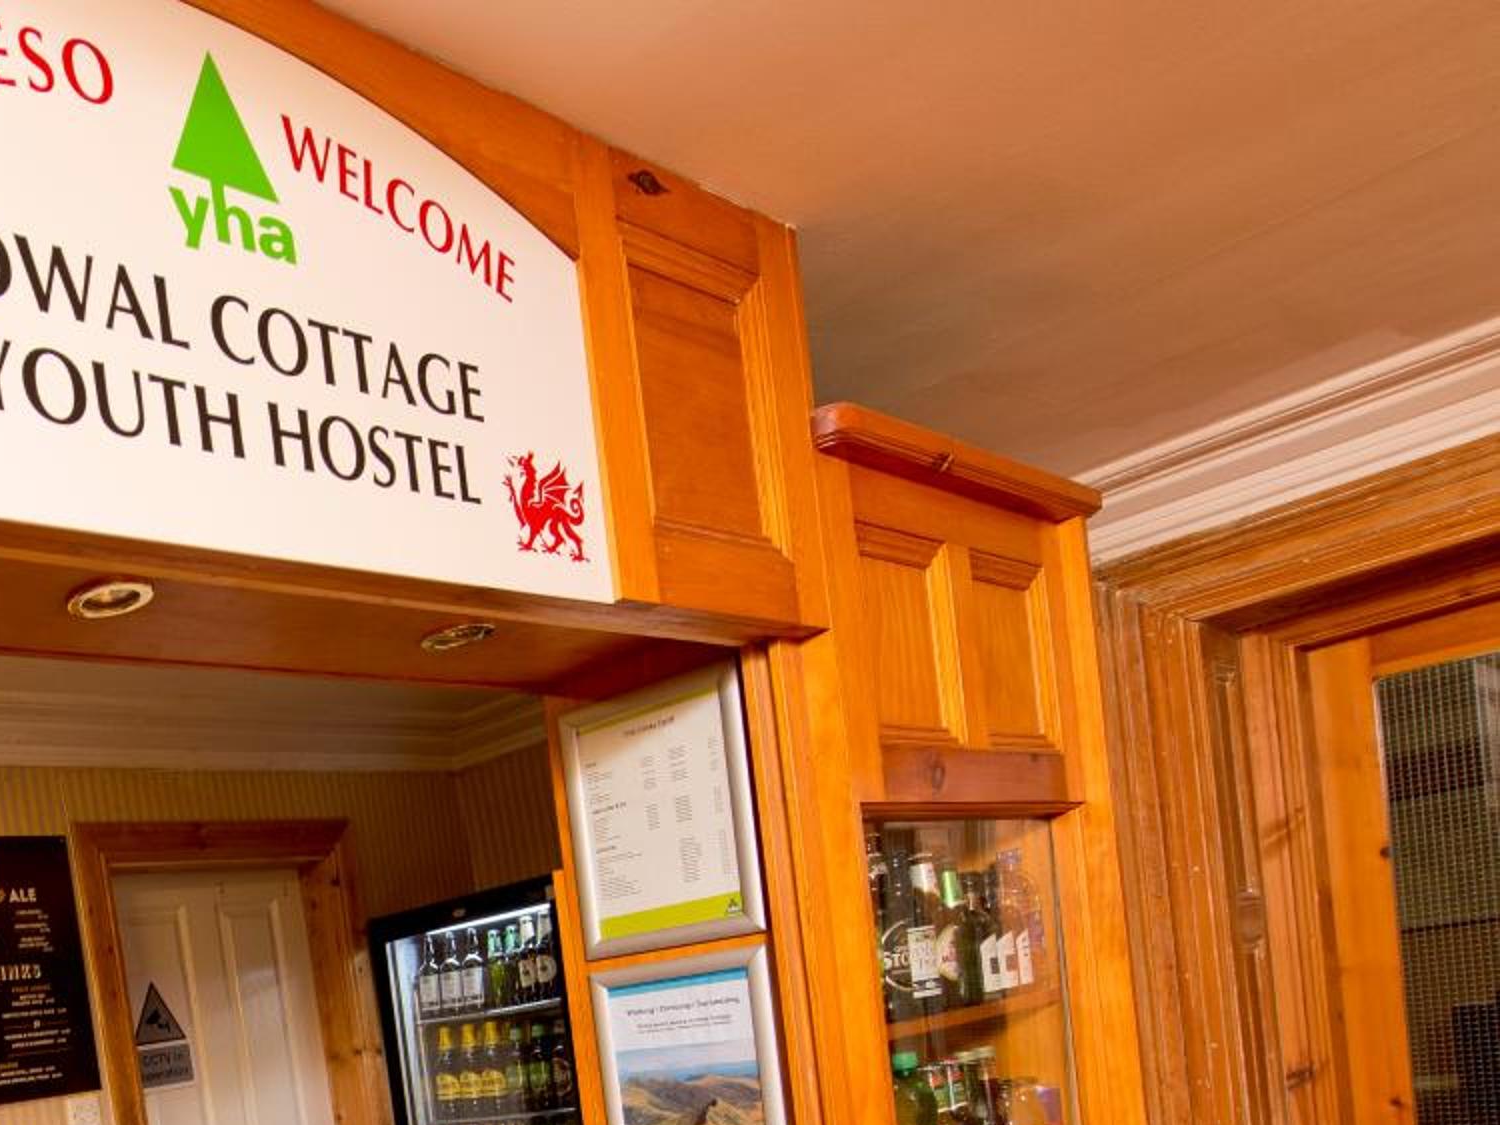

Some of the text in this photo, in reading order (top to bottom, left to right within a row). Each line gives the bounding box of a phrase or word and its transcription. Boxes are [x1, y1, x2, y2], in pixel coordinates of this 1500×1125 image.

[169, 186, 298, 266] yha
[280, 114, 516, 304] WELCOME
[210, 295, 485, 424] COTTAGE
[268, 402, 482, 506] HOSTEL
[9, 888, 37, 903] ALE
